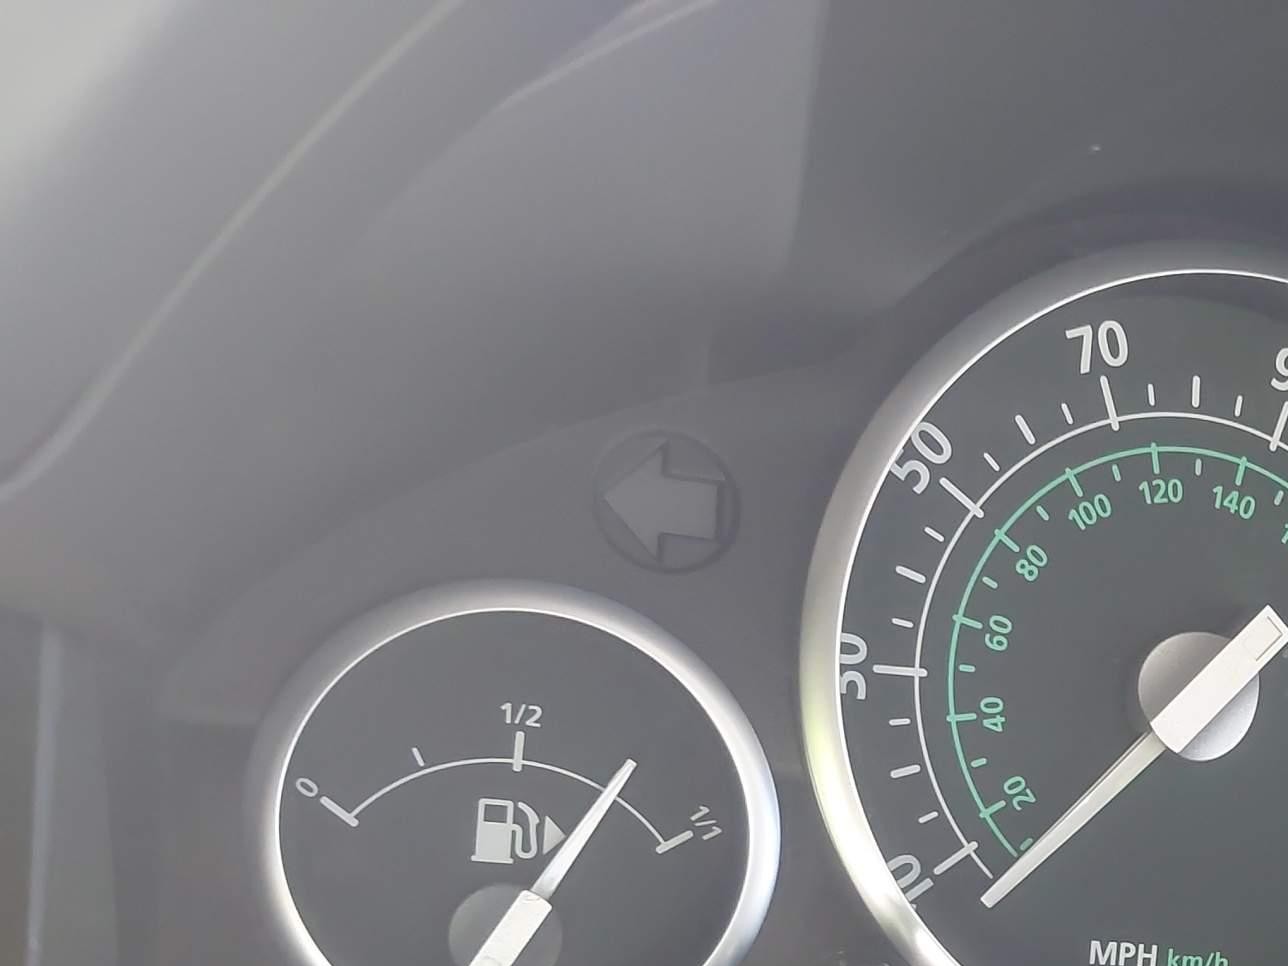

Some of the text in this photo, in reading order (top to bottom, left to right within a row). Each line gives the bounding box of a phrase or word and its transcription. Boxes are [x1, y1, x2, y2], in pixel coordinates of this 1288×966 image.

[1065, 320, 1129, 374] 70
[890, 421, 952, 495] 50
[1139, 478, 1183, 505] 120
[1212, 486, 1256, 520] 140
[1068, 494, 1112, 530] 100
[1015, 544, 1048, 582] 80
[984, 615, 1013, 651] 60
[500, 702, 543, 728] 1/2
[979, 696, 1006, 732] 40
[295, 777, 319, 798] 0
[1003, 775, 1036, 811] 20
[690, 805, 723, 842] 1/1
